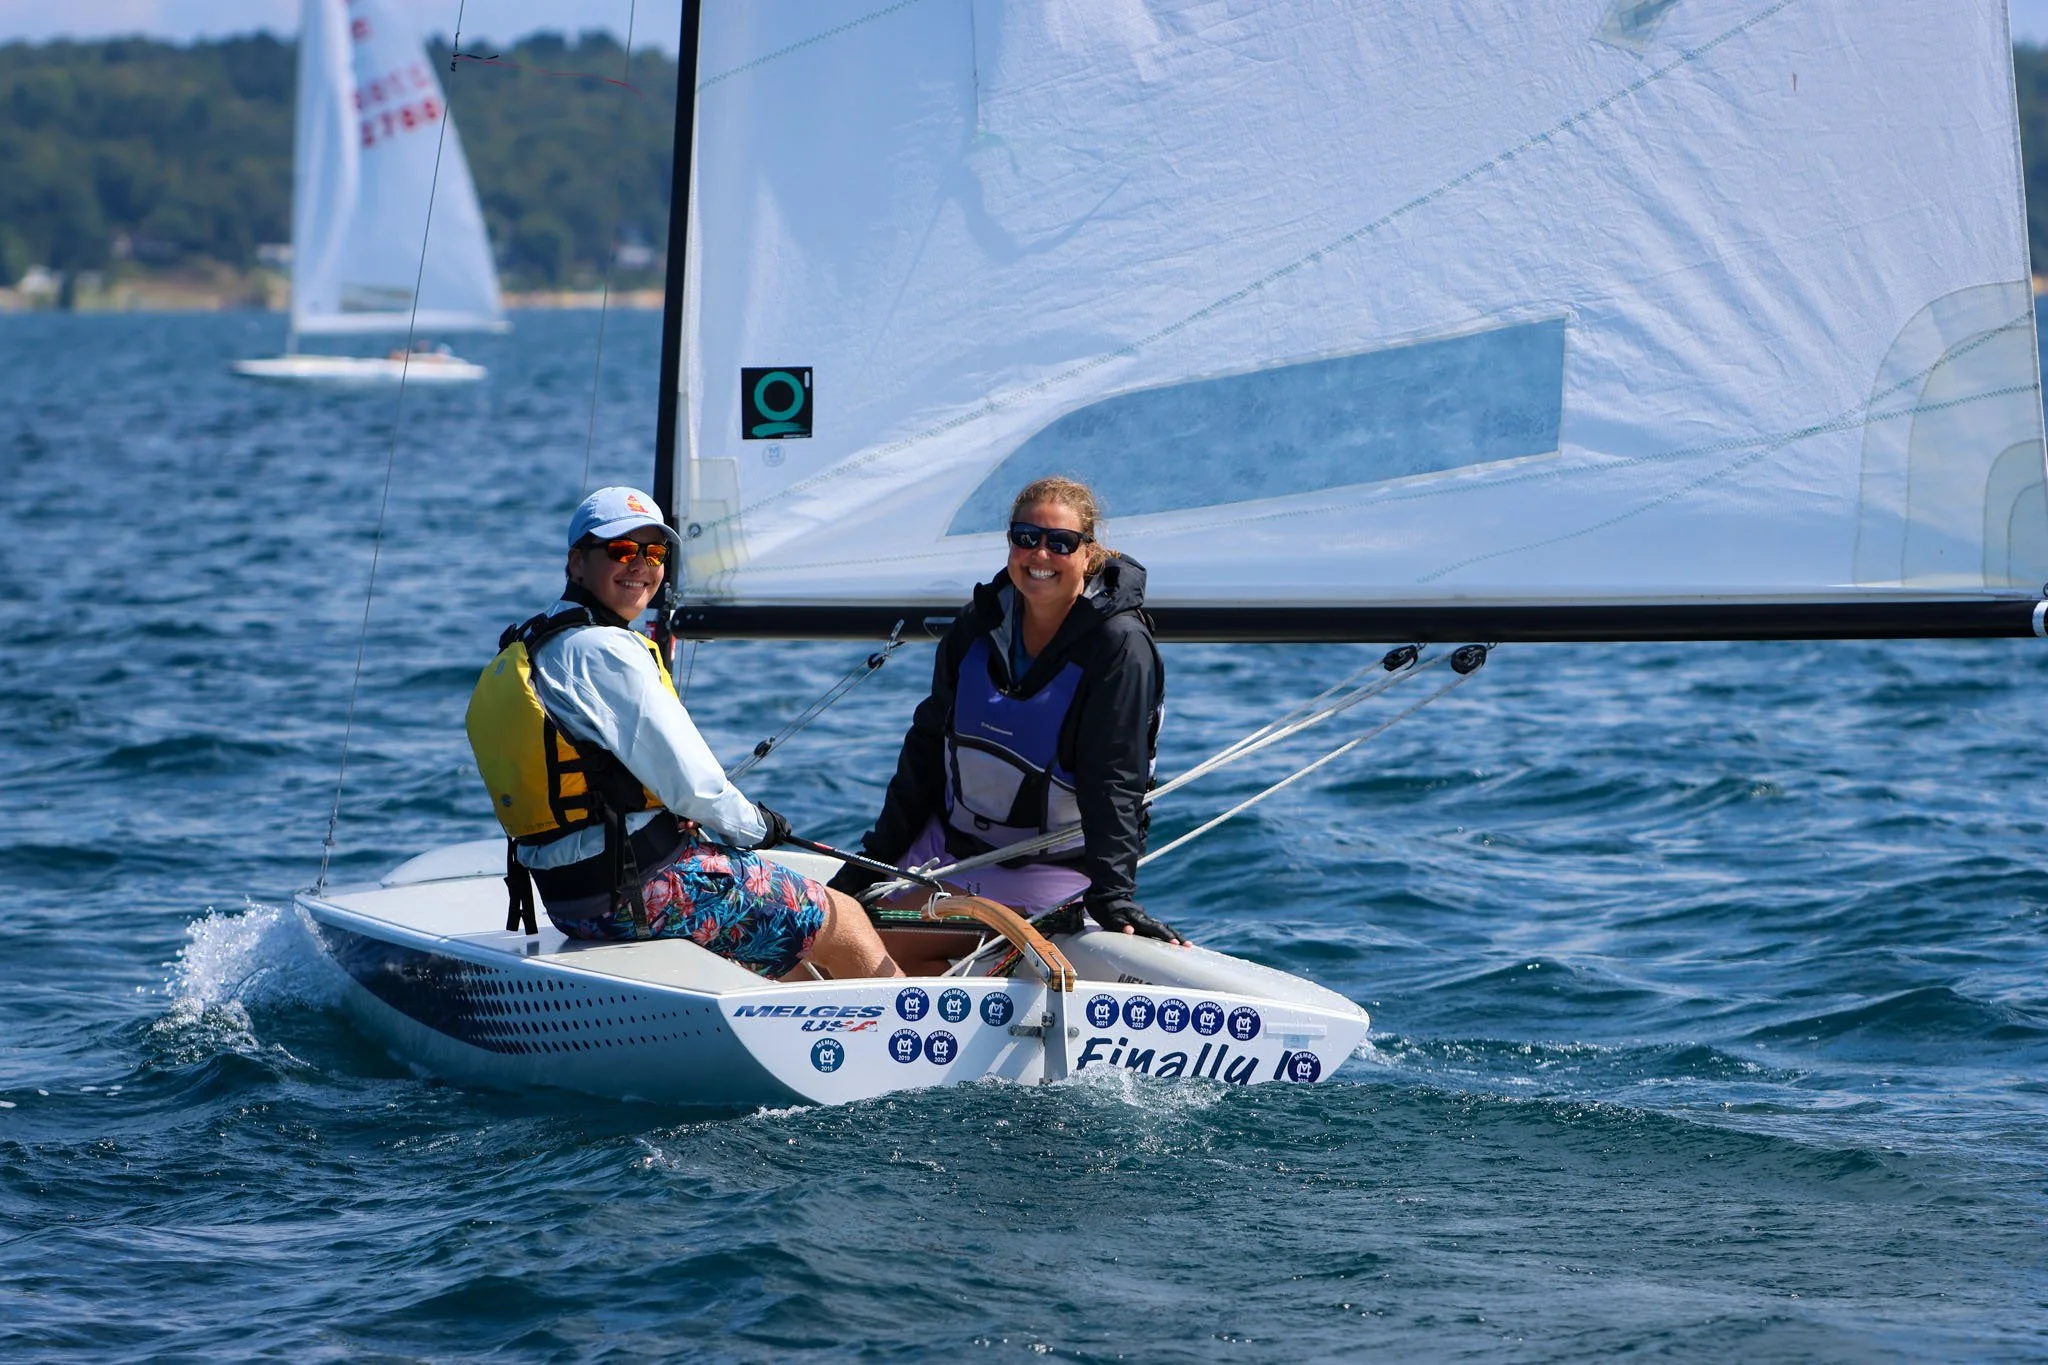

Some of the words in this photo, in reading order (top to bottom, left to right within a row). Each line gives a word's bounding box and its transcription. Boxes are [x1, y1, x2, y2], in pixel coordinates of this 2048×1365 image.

[901, 988, 925, 998] MEMBER
[943, 989, 967, 999] MEMBER
[986, 993, 1010, 1004] MEMBER
[1091, 994, 1115, 1004] MEMBER
[1128, 996, 1151, 1006] MEMBER
[1162, 999, 1186, 1010] MEMBER
[733, 1005, 886, 1018] MELGES
[1198, 1002, 1222, 1013] MEMBER
[1233, 1007, 1257, 1018] MEMBER
[801, 1020, 878, 1032] USA
[894, 1029, 918, 1039] MEMBER
[930, 1031, 954, 1041] MEMBER
[816, 1039, 841, 1049] MEMBER
[1076, 1036, 1260, 1085] Finally
[1294, 1052, 1318, 1063] MEMBER
